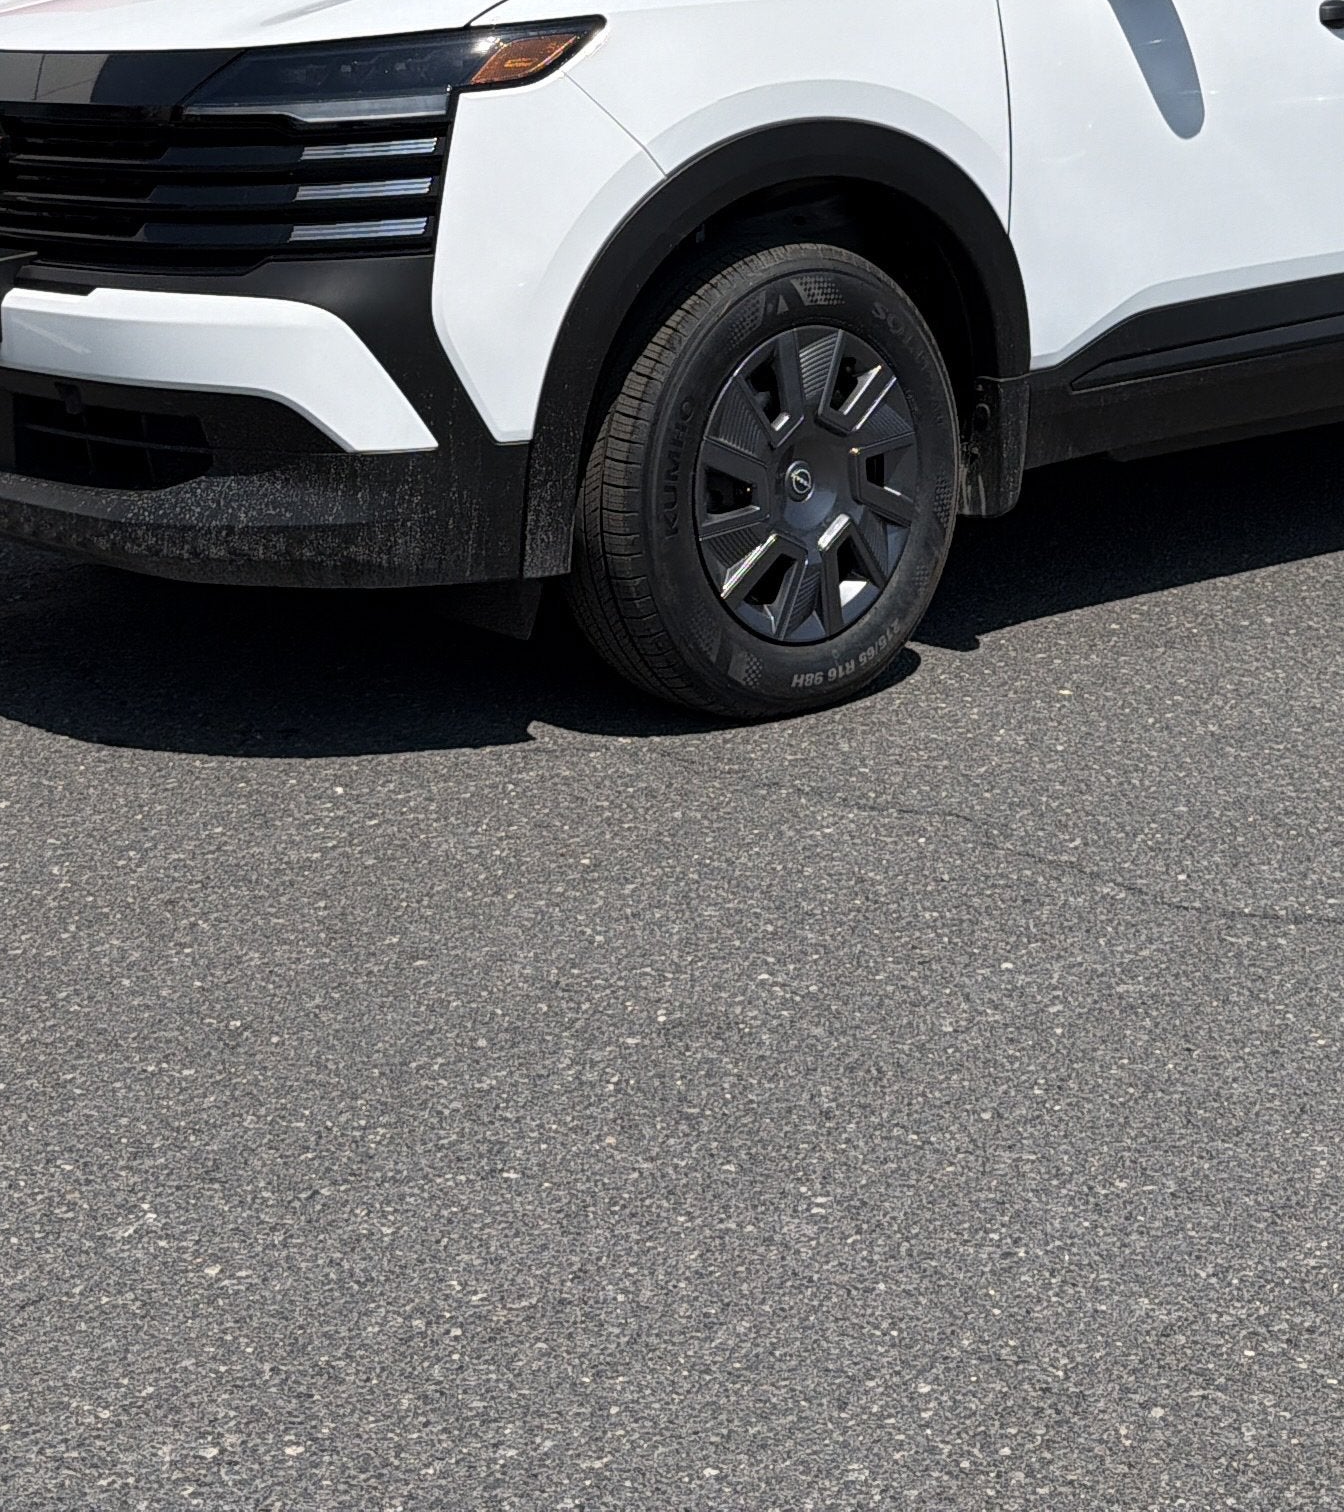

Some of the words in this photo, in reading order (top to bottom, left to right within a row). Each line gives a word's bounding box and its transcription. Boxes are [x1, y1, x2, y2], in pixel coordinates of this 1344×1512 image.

[664, 396, 694, 539] KUMHO
[791, 672, 824, 687] 98H
[828, 659, 855, 682] R16
